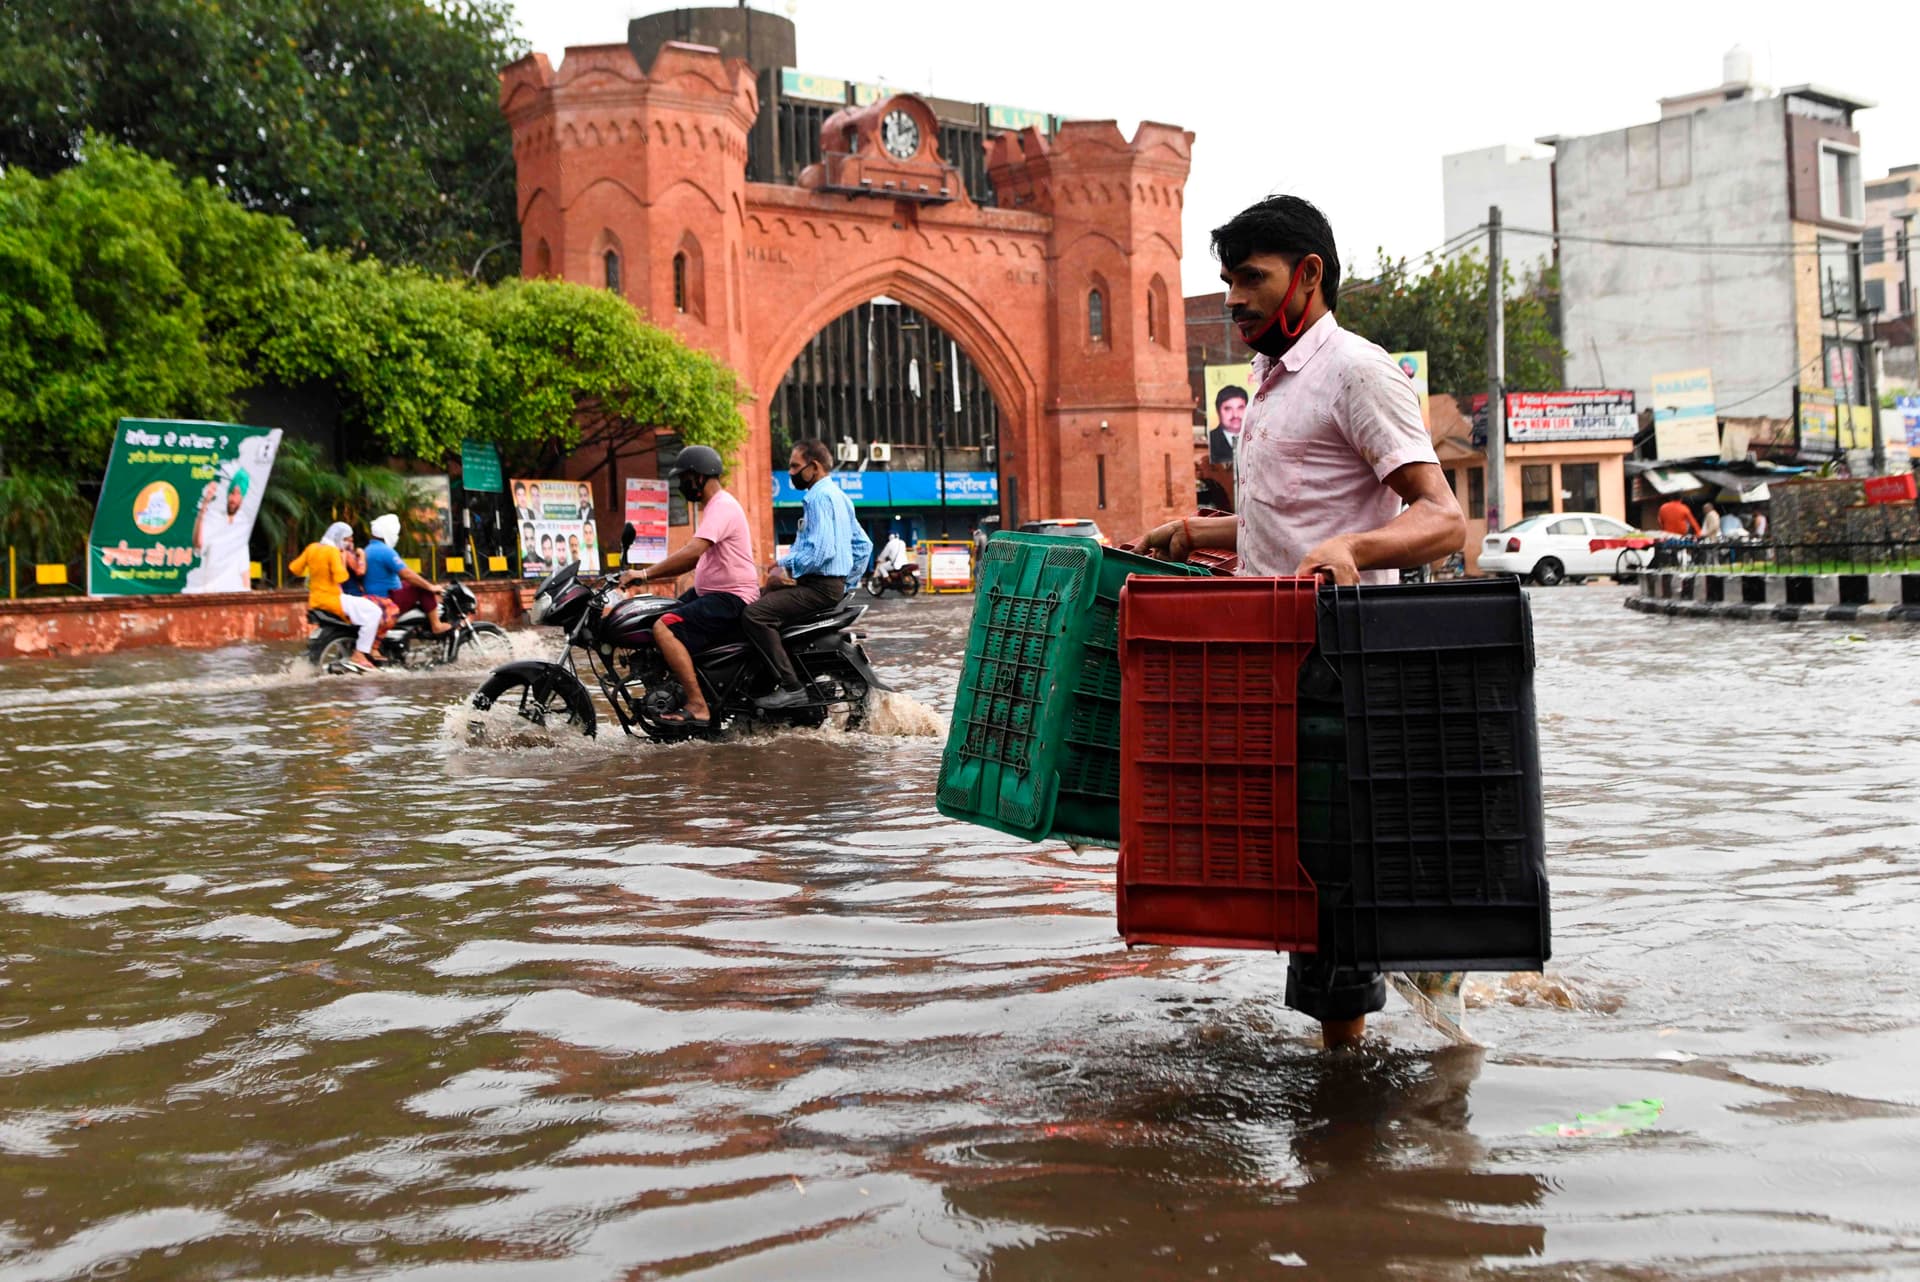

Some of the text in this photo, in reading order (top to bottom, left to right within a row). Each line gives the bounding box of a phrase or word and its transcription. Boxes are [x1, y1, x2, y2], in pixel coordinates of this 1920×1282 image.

[746, 247, 788, 264] HALL
[1512, 405, 1544, 418] Police
[1530, 416, 1616, 429] NEW LIFE HOSPITAL
